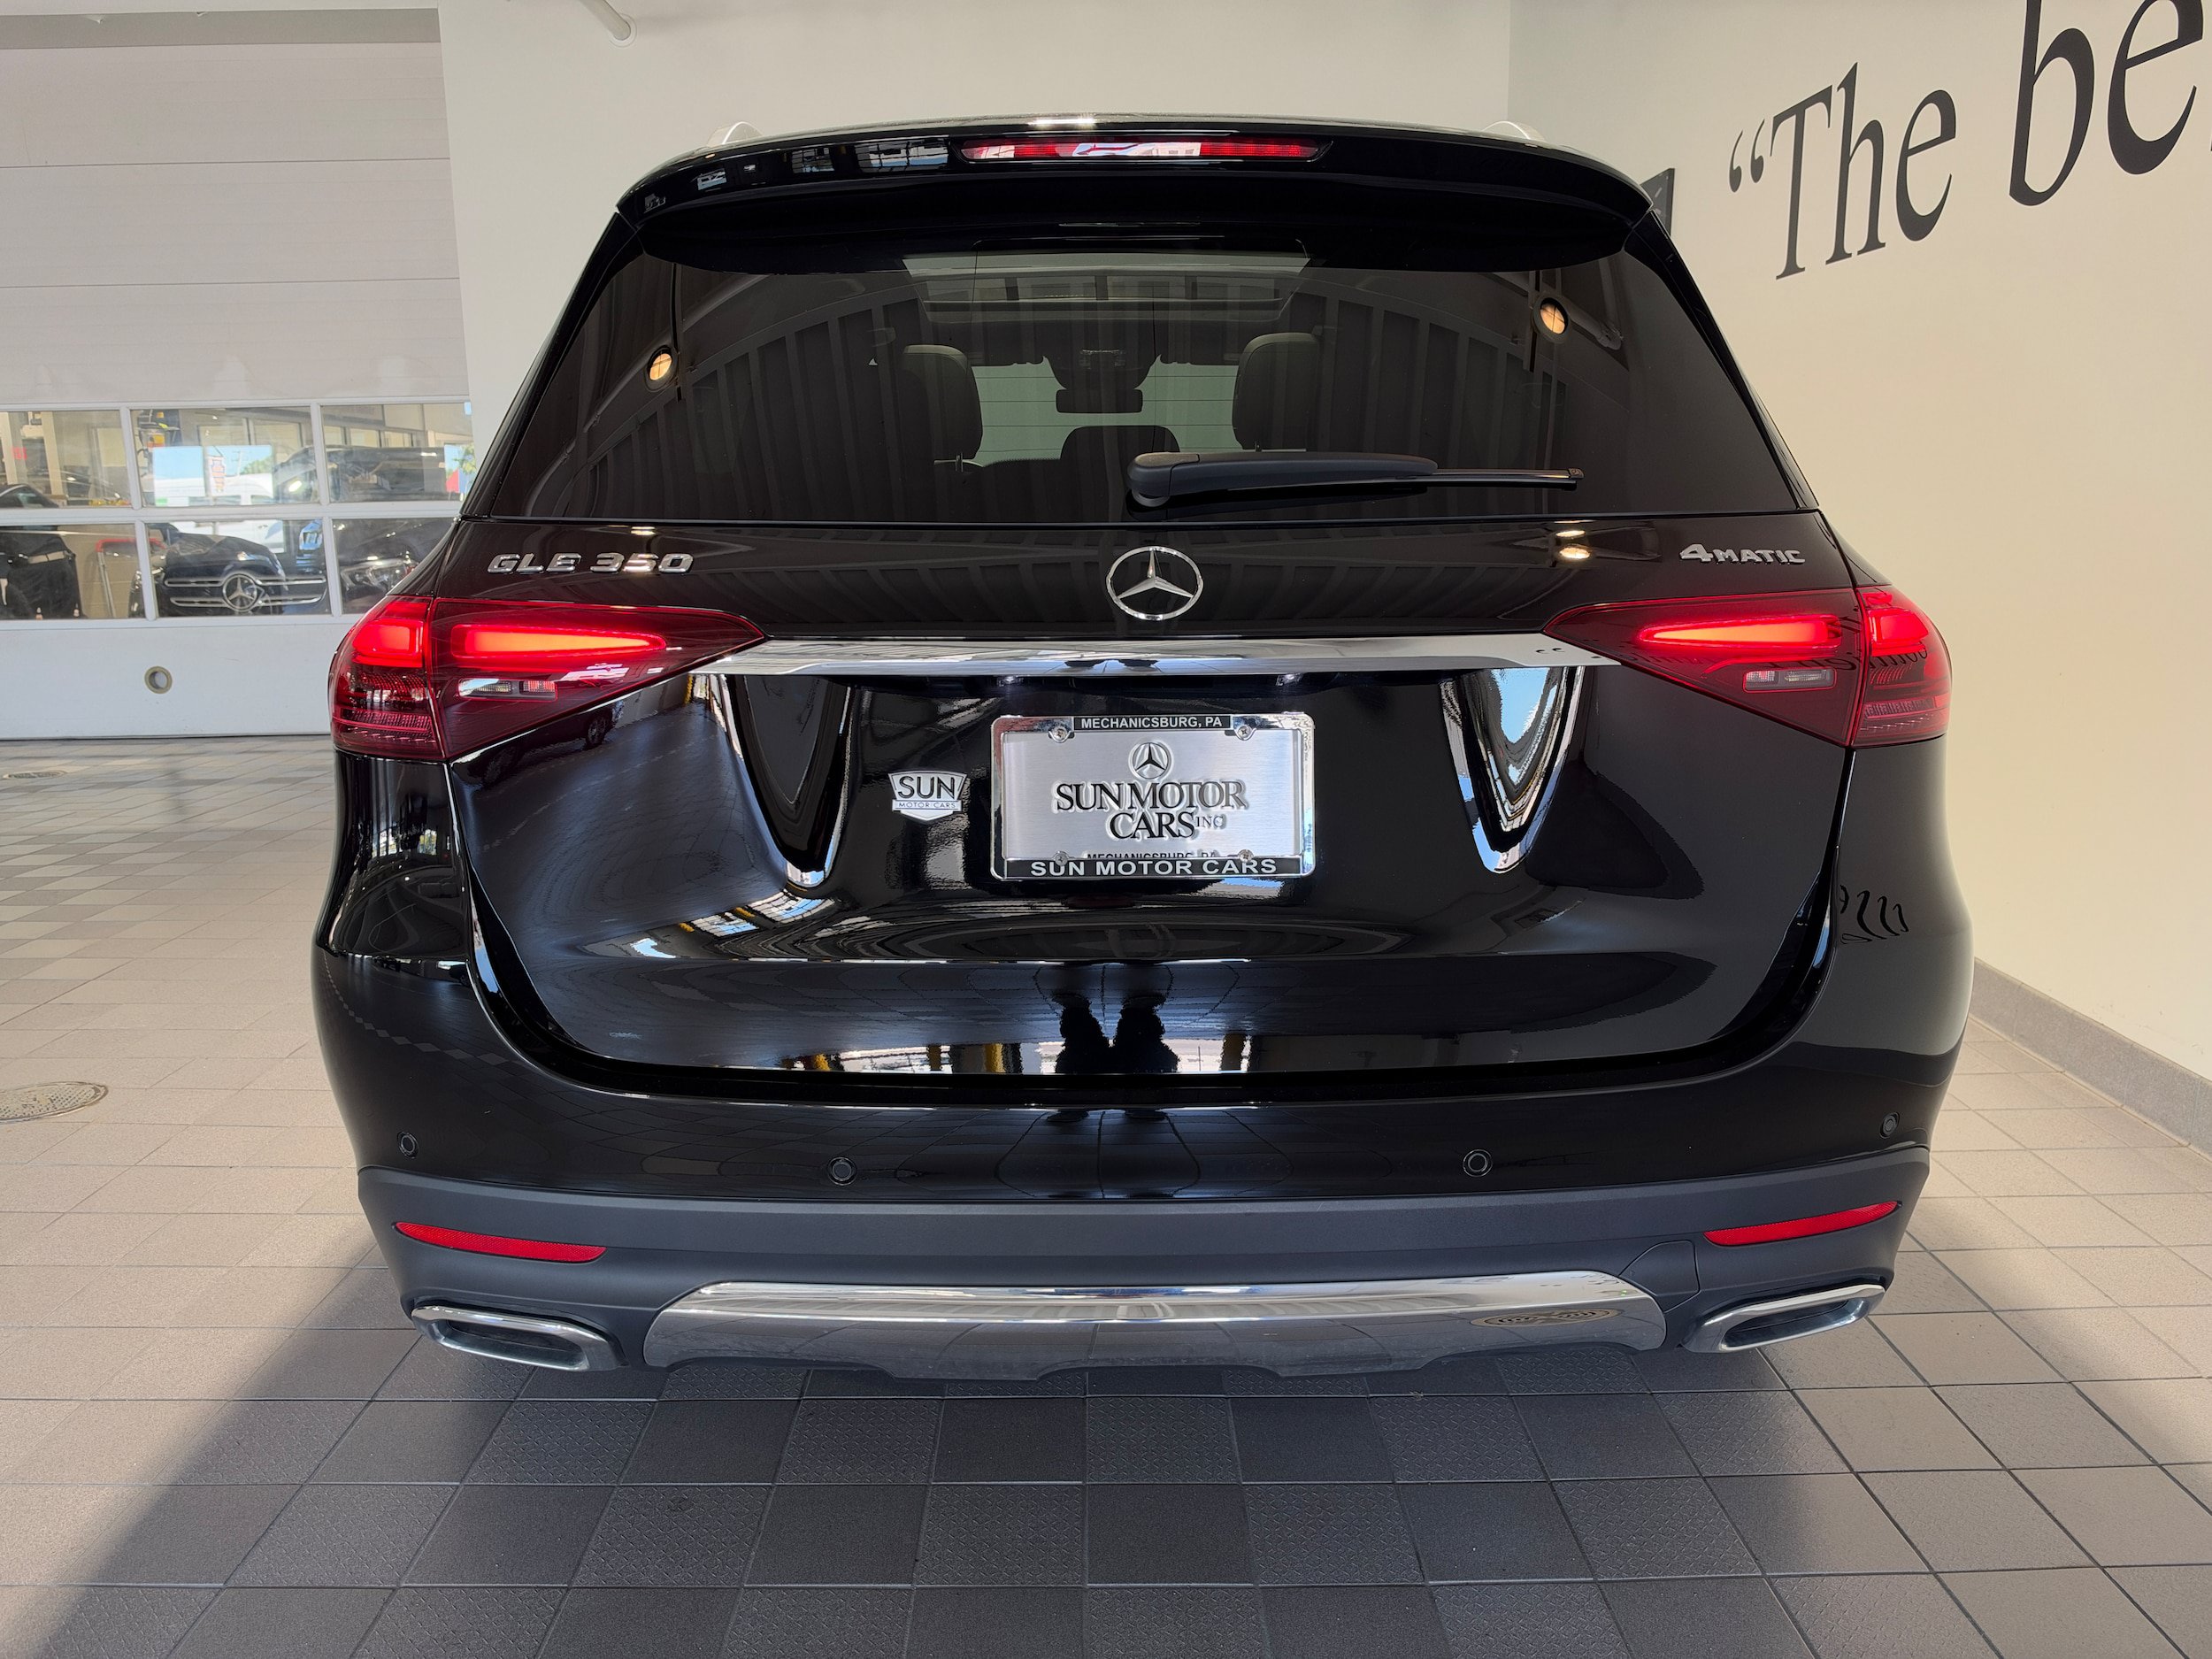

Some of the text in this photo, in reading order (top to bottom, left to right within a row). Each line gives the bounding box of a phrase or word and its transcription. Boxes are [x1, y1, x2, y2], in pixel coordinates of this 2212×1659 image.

[487, 552, 695, 574] GLE 350
[1680, 543, 1806, 564] 4MATIC
[1081, 717, 1223, 730] MECHANICSBURG, PA
[897, 775, 956, 799] SUN
[1056, 780, 1247, 810] SUN MOTOR
[1110, 811, 1225, 840] CARS INC
[1031, 858, 1277, 876] SUN MOTOR CARS
